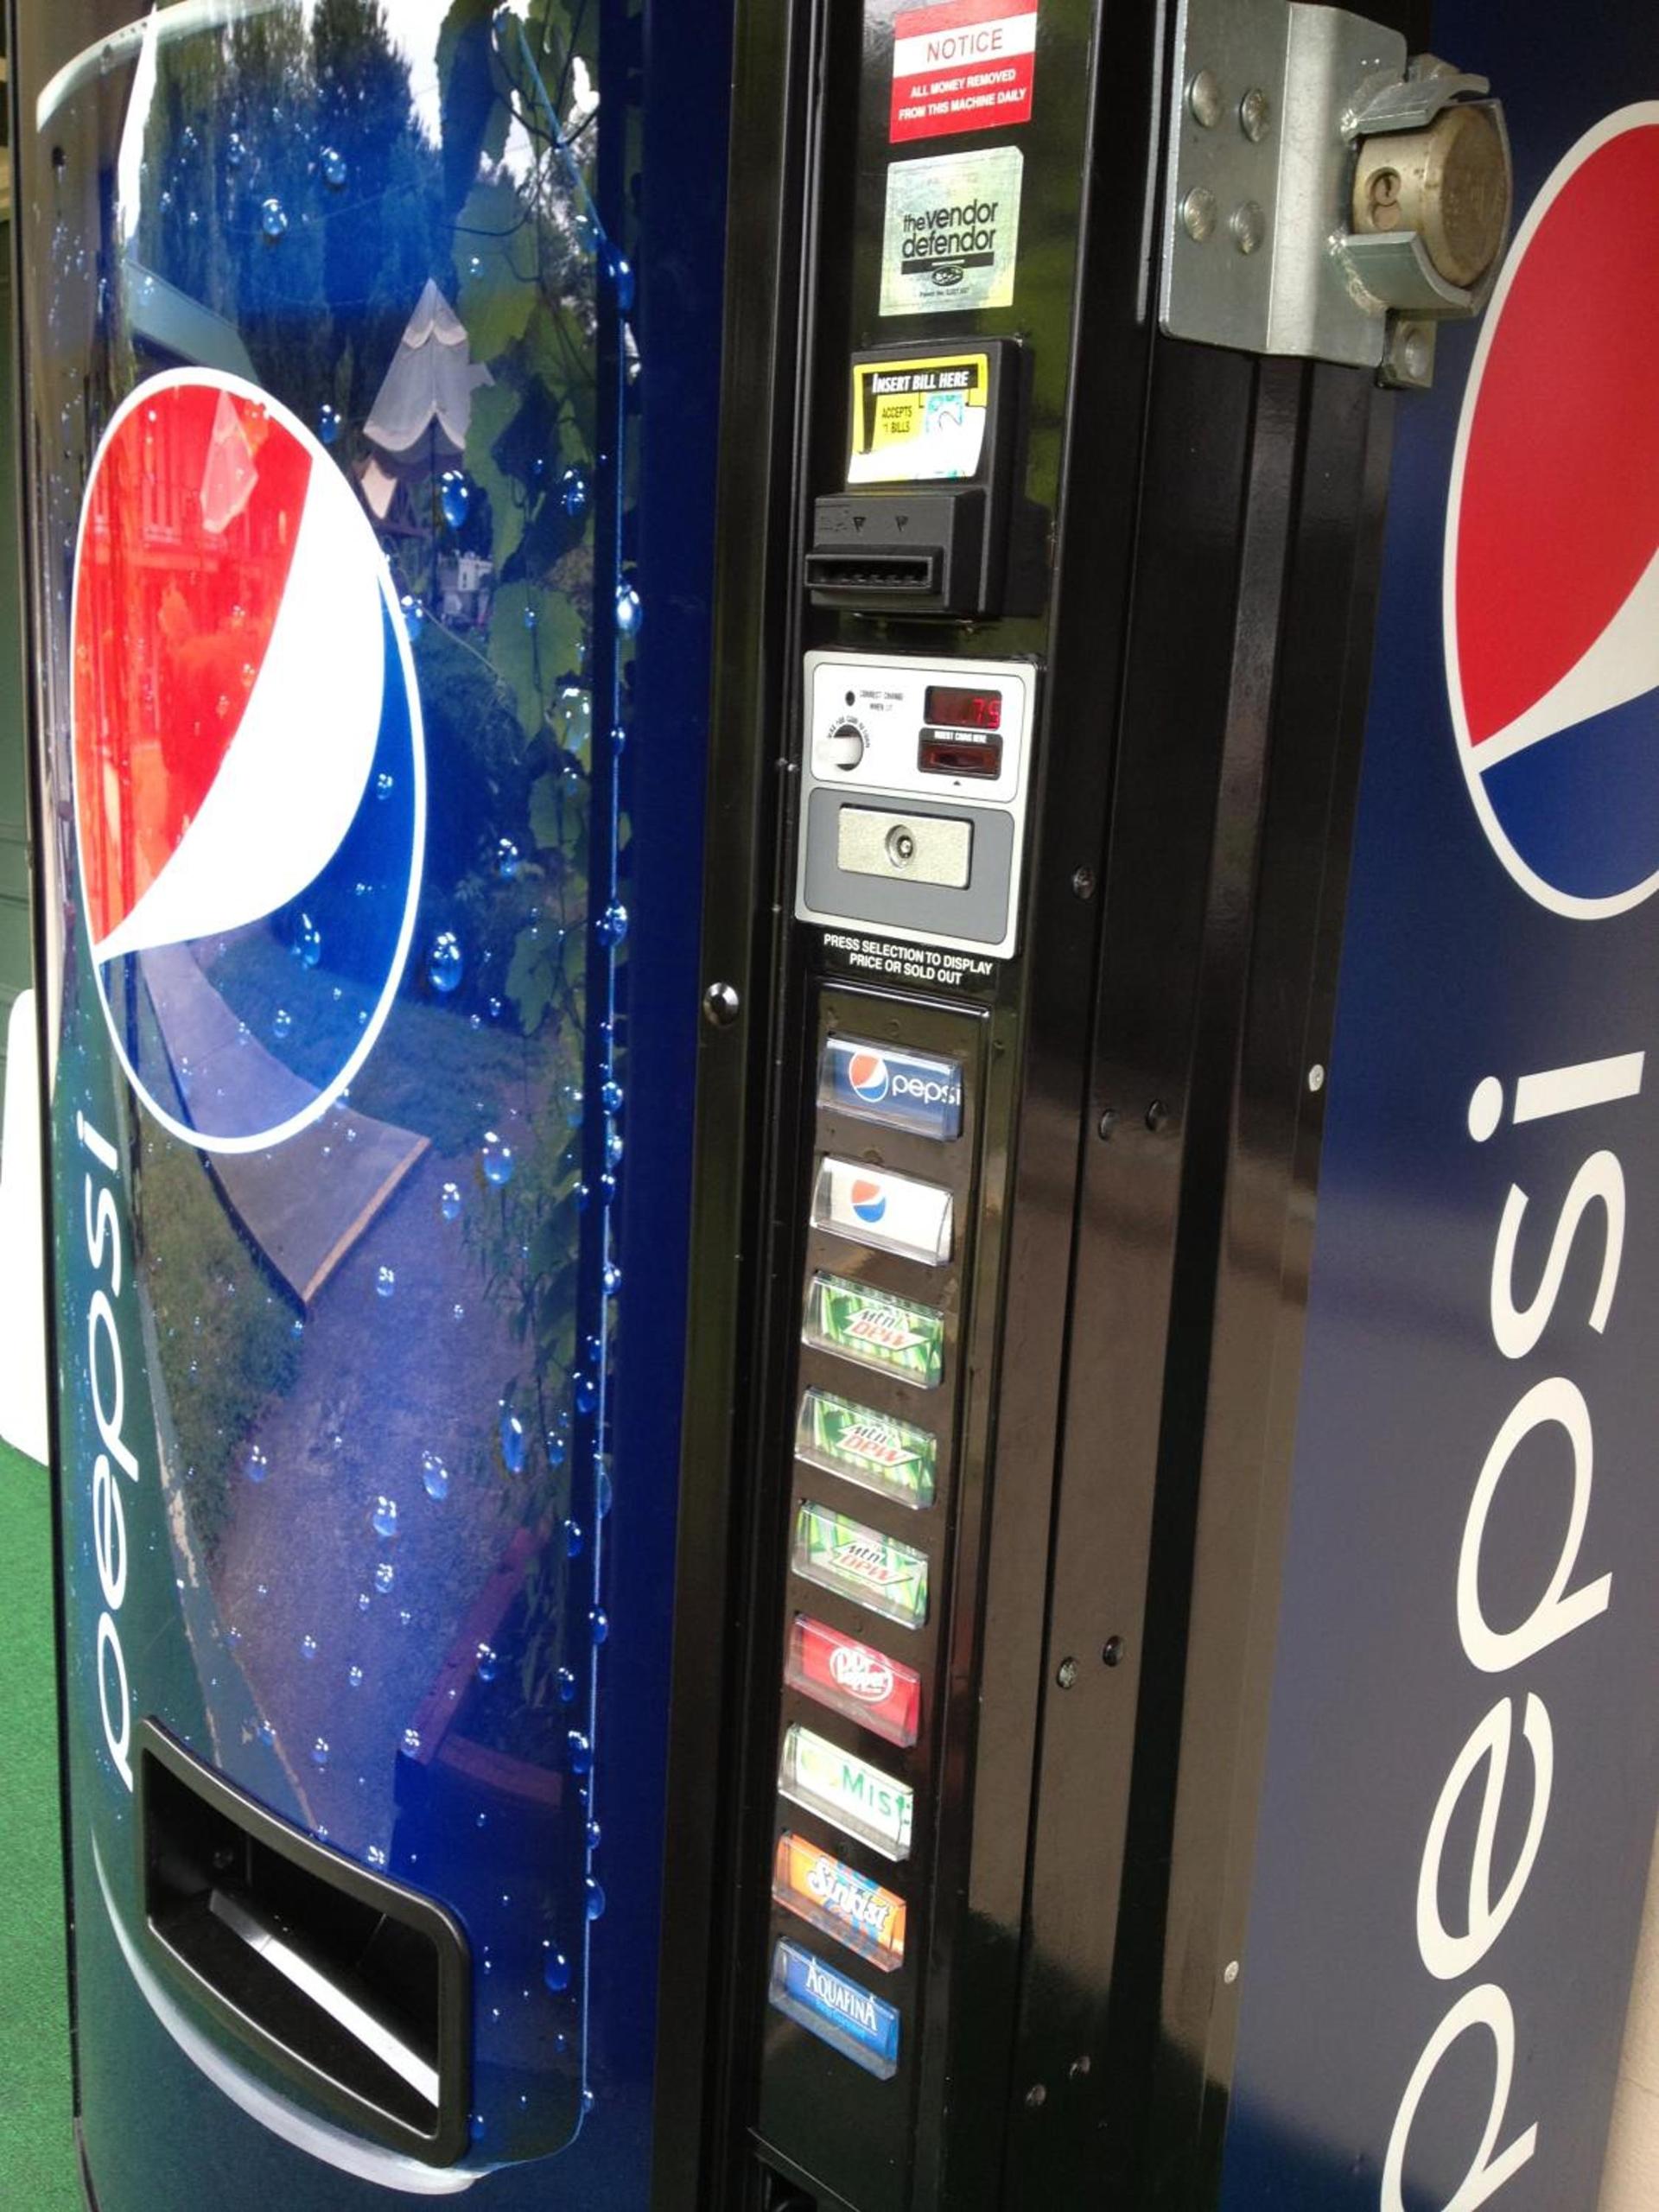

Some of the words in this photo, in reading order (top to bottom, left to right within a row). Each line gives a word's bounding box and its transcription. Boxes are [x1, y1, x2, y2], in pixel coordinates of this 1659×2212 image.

[926, 28, 1003, 63] NOTICE
[911, 85, 929, 98] ALL
[930, 78, 966, 94] MONEY
[966, 68, 1016, 88] REMOVED
[899, 105, 926, 121] FROM
[927, 101, 950, 115] THIS
[950, 92, 996, 111] MACHINE
[996, 88, 1027, 103] DAILY
[902, 225, 996, 258] defendor
[872, 373, 911, 394] INSERT
[912, 374, 937, 390] BILL
[938, 371, 969, 388] HERE
[823, 934, 861, 951] PRESS
[861, 940, 925, 963] SELECTION
[925, 951, 942, 966] TO
[944, 956, 994, 976] DISPLAY
[849, 952, 883, 970] PRICE
[884, 958, 903, 974] OR
[903, 963, 936, 980] SOLD
[937, 969, 963, 985] OUT
[892, 1074, 961, 1106] pepsi
[76, 1109, 139, 1793] pepsi
[1381, 1050, 1647, 2212] pepsi
[805, 1955, 879, 2031] AQUAFINA
